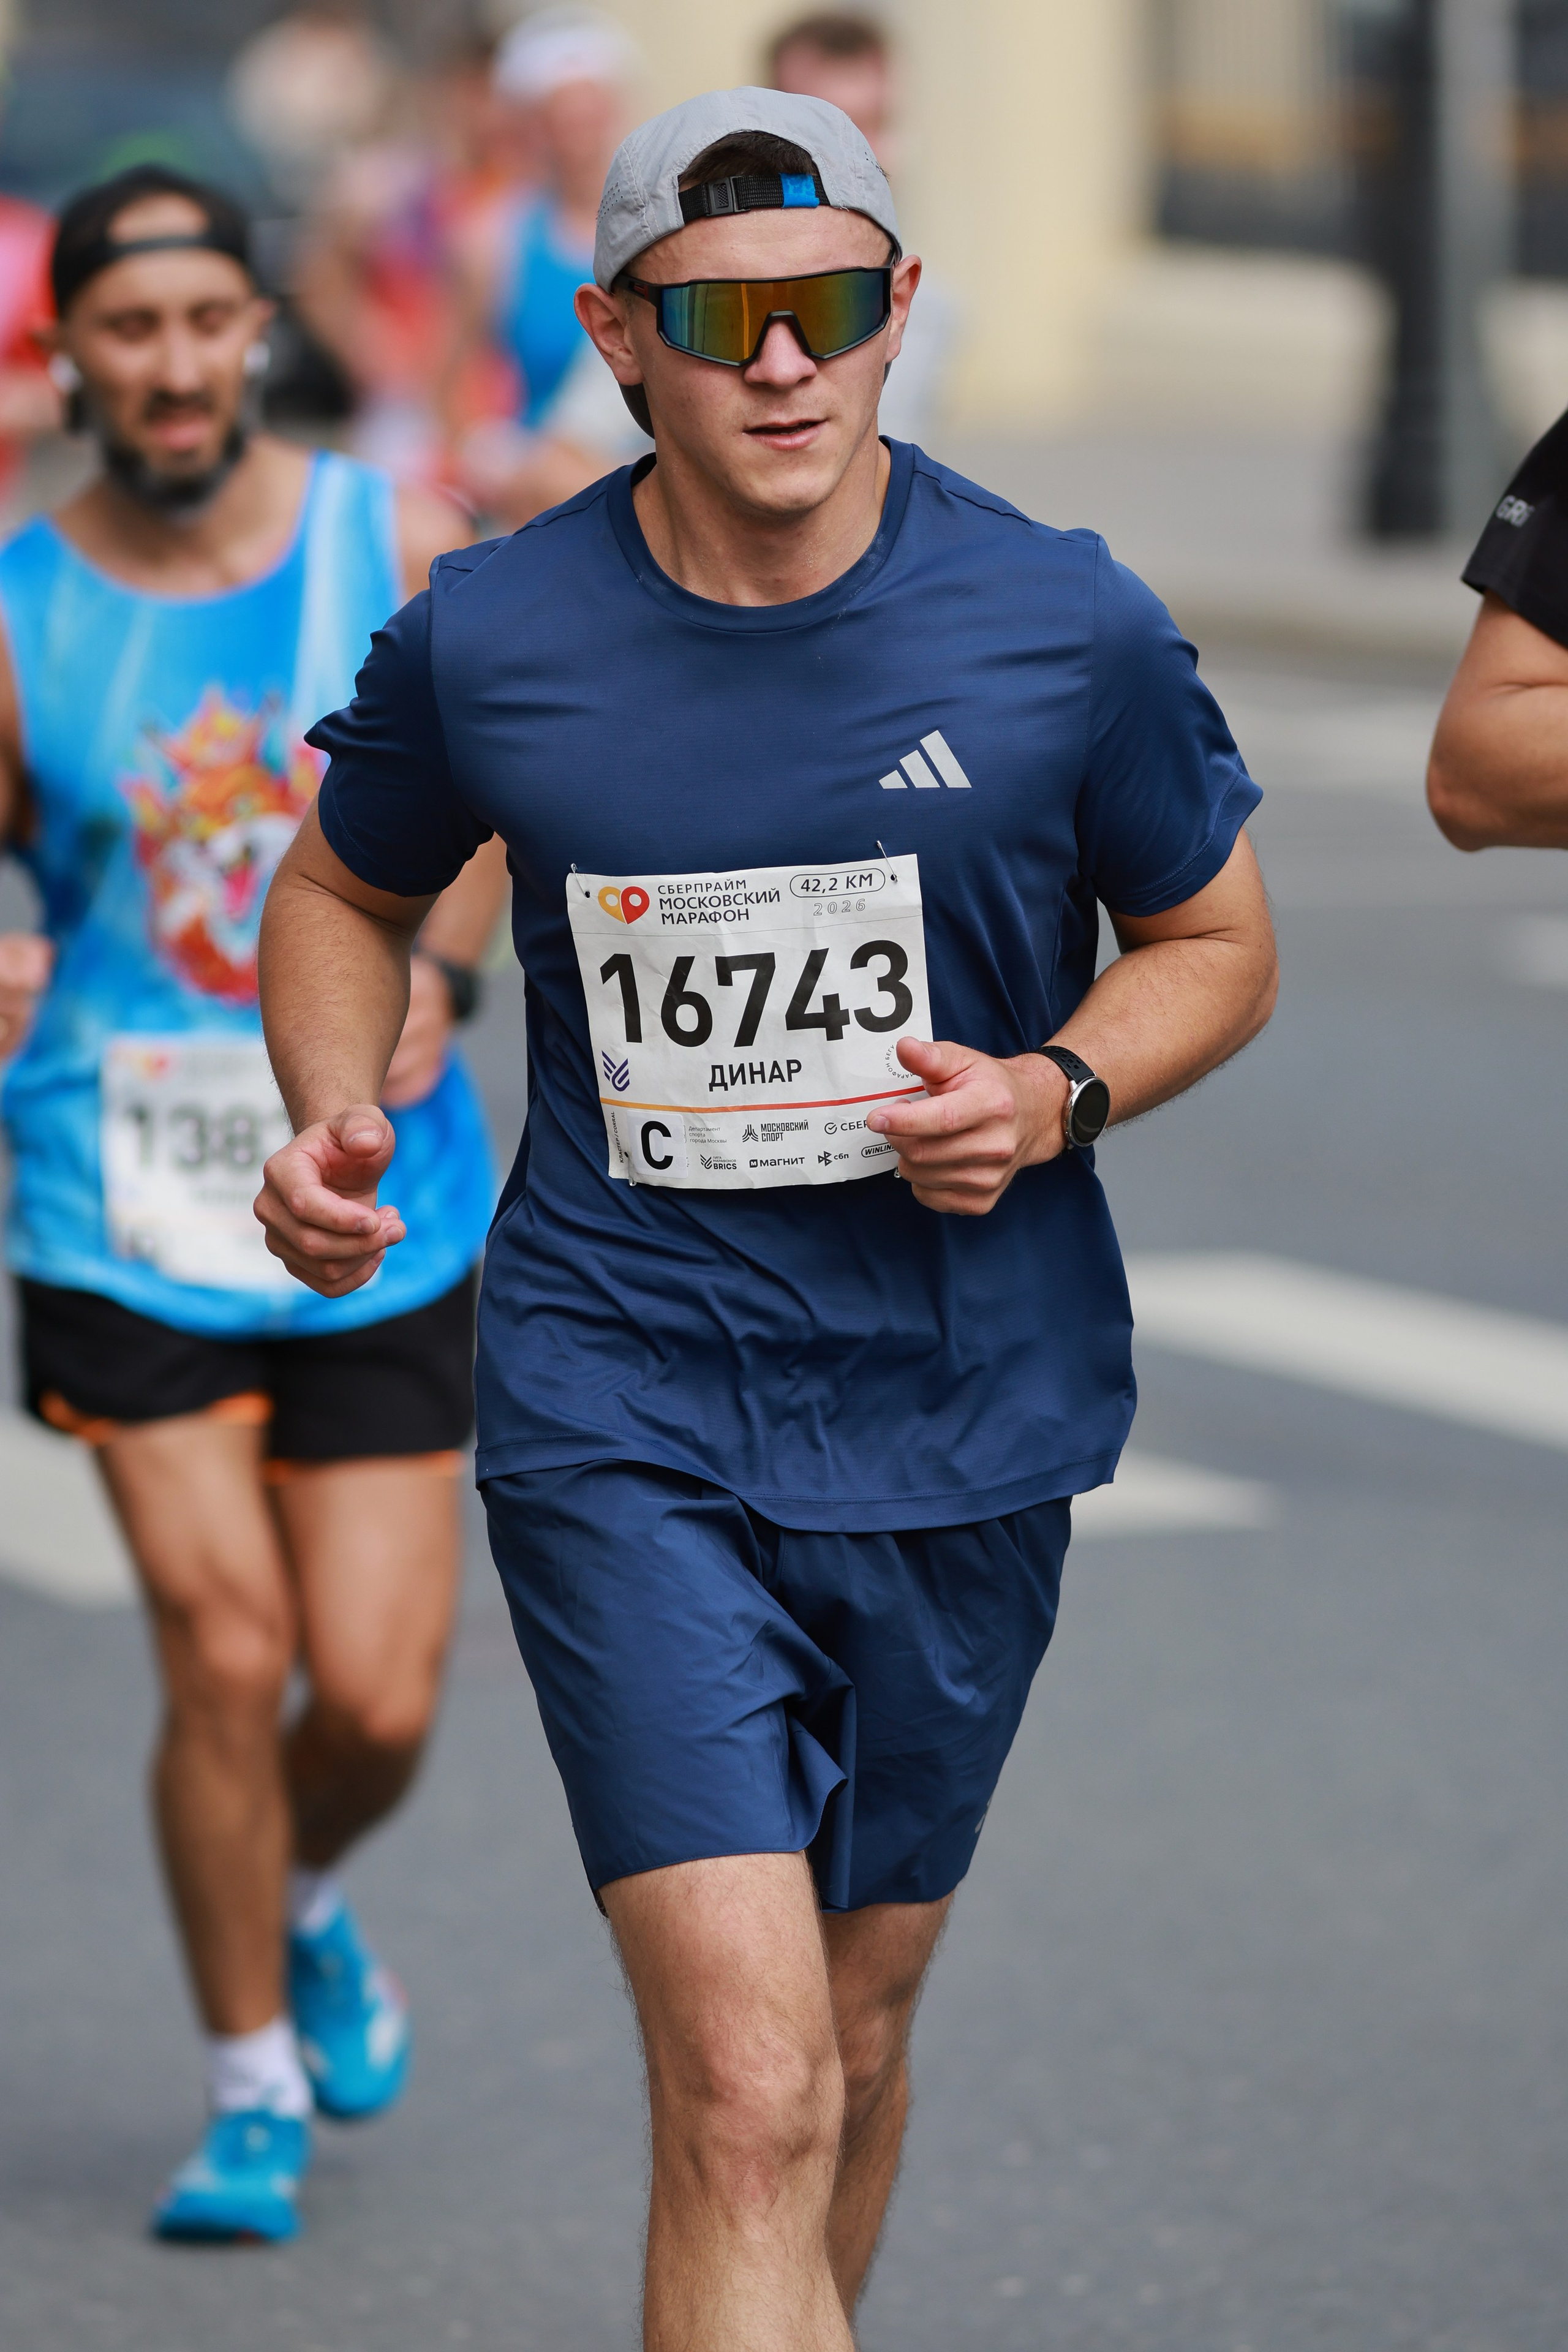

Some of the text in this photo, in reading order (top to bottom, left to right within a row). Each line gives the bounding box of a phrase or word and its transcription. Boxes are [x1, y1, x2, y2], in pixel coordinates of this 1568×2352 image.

[657, 878, 747, 895] СБЕРПРАЙМ
[801, 873, 873, 894] 42,2 КМ
[659, 888, 780, 910] МОСКОВСКИЙ
[813, 898, 866, 916] 2026
[661, 908, 750, 925] МАРАФОН
[600, 940, 913, 1048] 16743
[885, 1044, 894, 1060] БЕГУ
[708, 1058, 802, 1092] ДИНАР
[761, 1119, 809, 1133] МОСКОВСКИЙ
[124, 1102, 293, 1172] 138
[761, 1132, 783, 1142] СПОРТ
[616, 1137, 624, 1163] КЛАСТЕР
[865, 1144, 894, 1155] WINLIN
